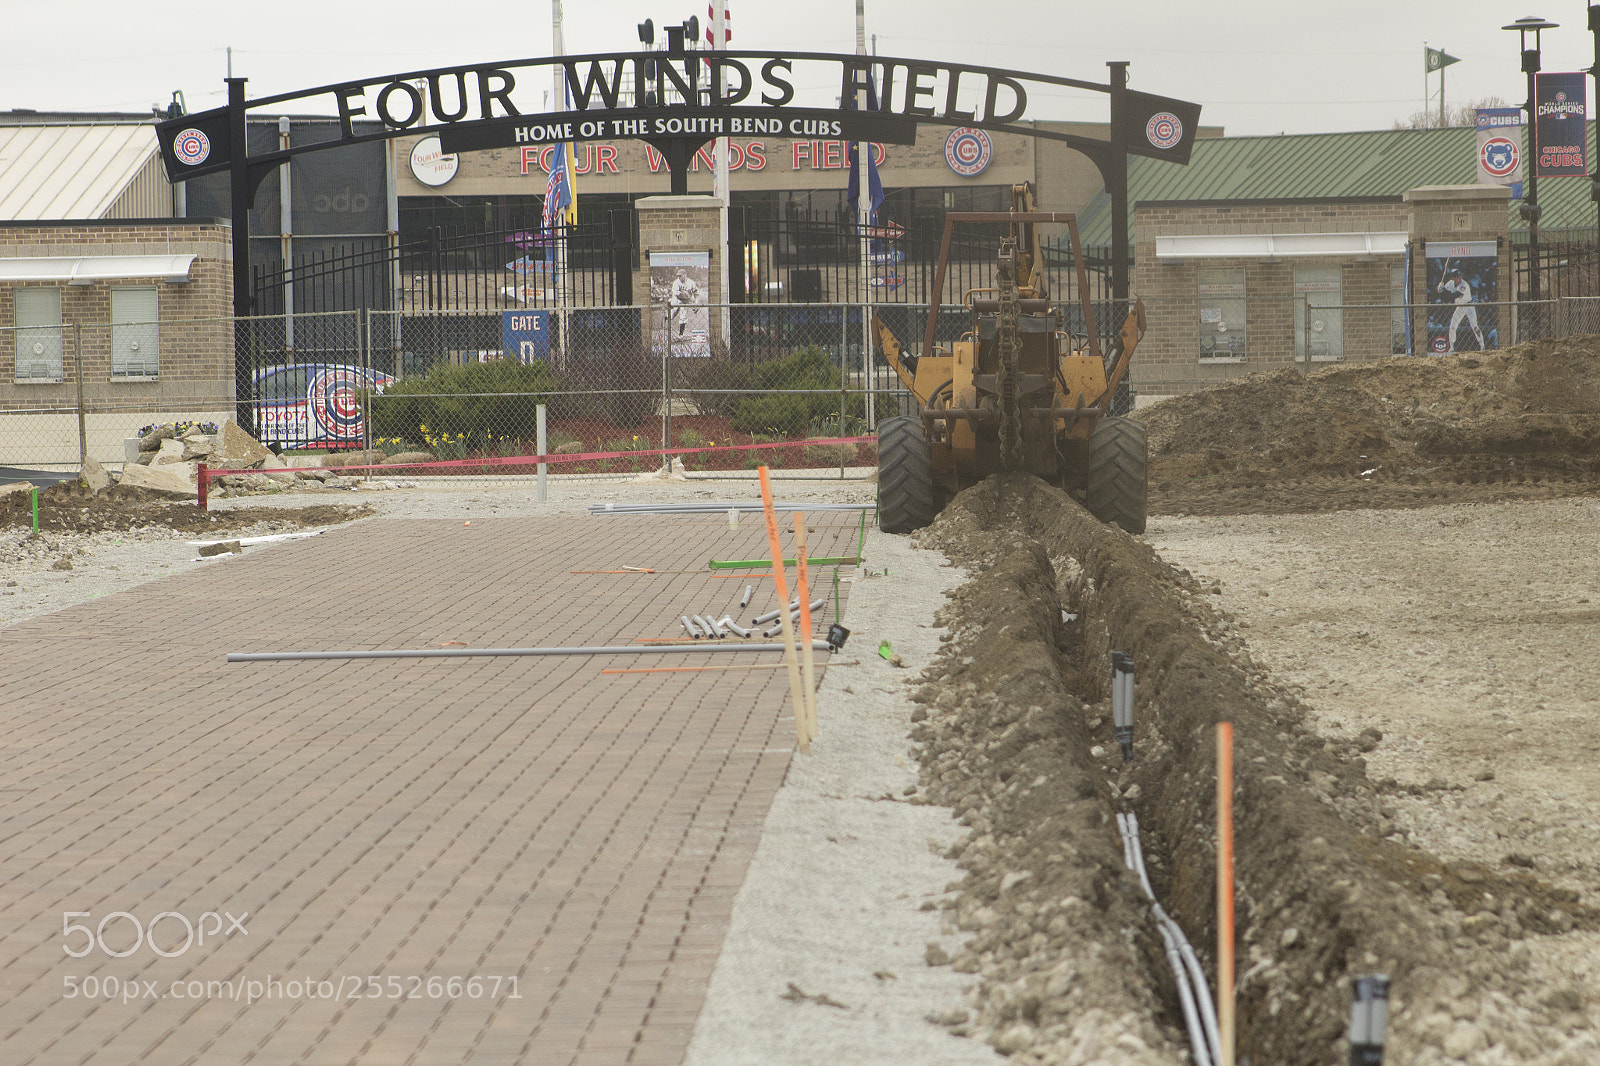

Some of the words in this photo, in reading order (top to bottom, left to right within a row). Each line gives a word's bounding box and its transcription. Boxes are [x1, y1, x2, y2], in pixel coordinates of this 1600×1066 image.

[334, 68, 521, 139] FOUR
[562, 57, 795, 110] WINDS
[840, 61, 1027, 124] FIELD
[1538, 104, 1585, 116] CHAMPIONS
[1490, 116, 1520, 126] CUBS
[514, 123, 574, 143] HOME
[580, 121, 606, 137] OF
[612, 119, 649, 135] THE
[655, 117, 724, 134] SOUTH
[730, 117, 783, 134] BEND
[789, 119, 842, 136] CUBS
[1543, 145, 1581, 154] CHICAGO
[645, 141, 767, 173] WNDS
[1540, 153, 1583, 168] CUBS
[434, 163, 454, 173] FIELD
[511, 315, 541, 331] GATE
[260, 411, 310, 422] TOYOTA
